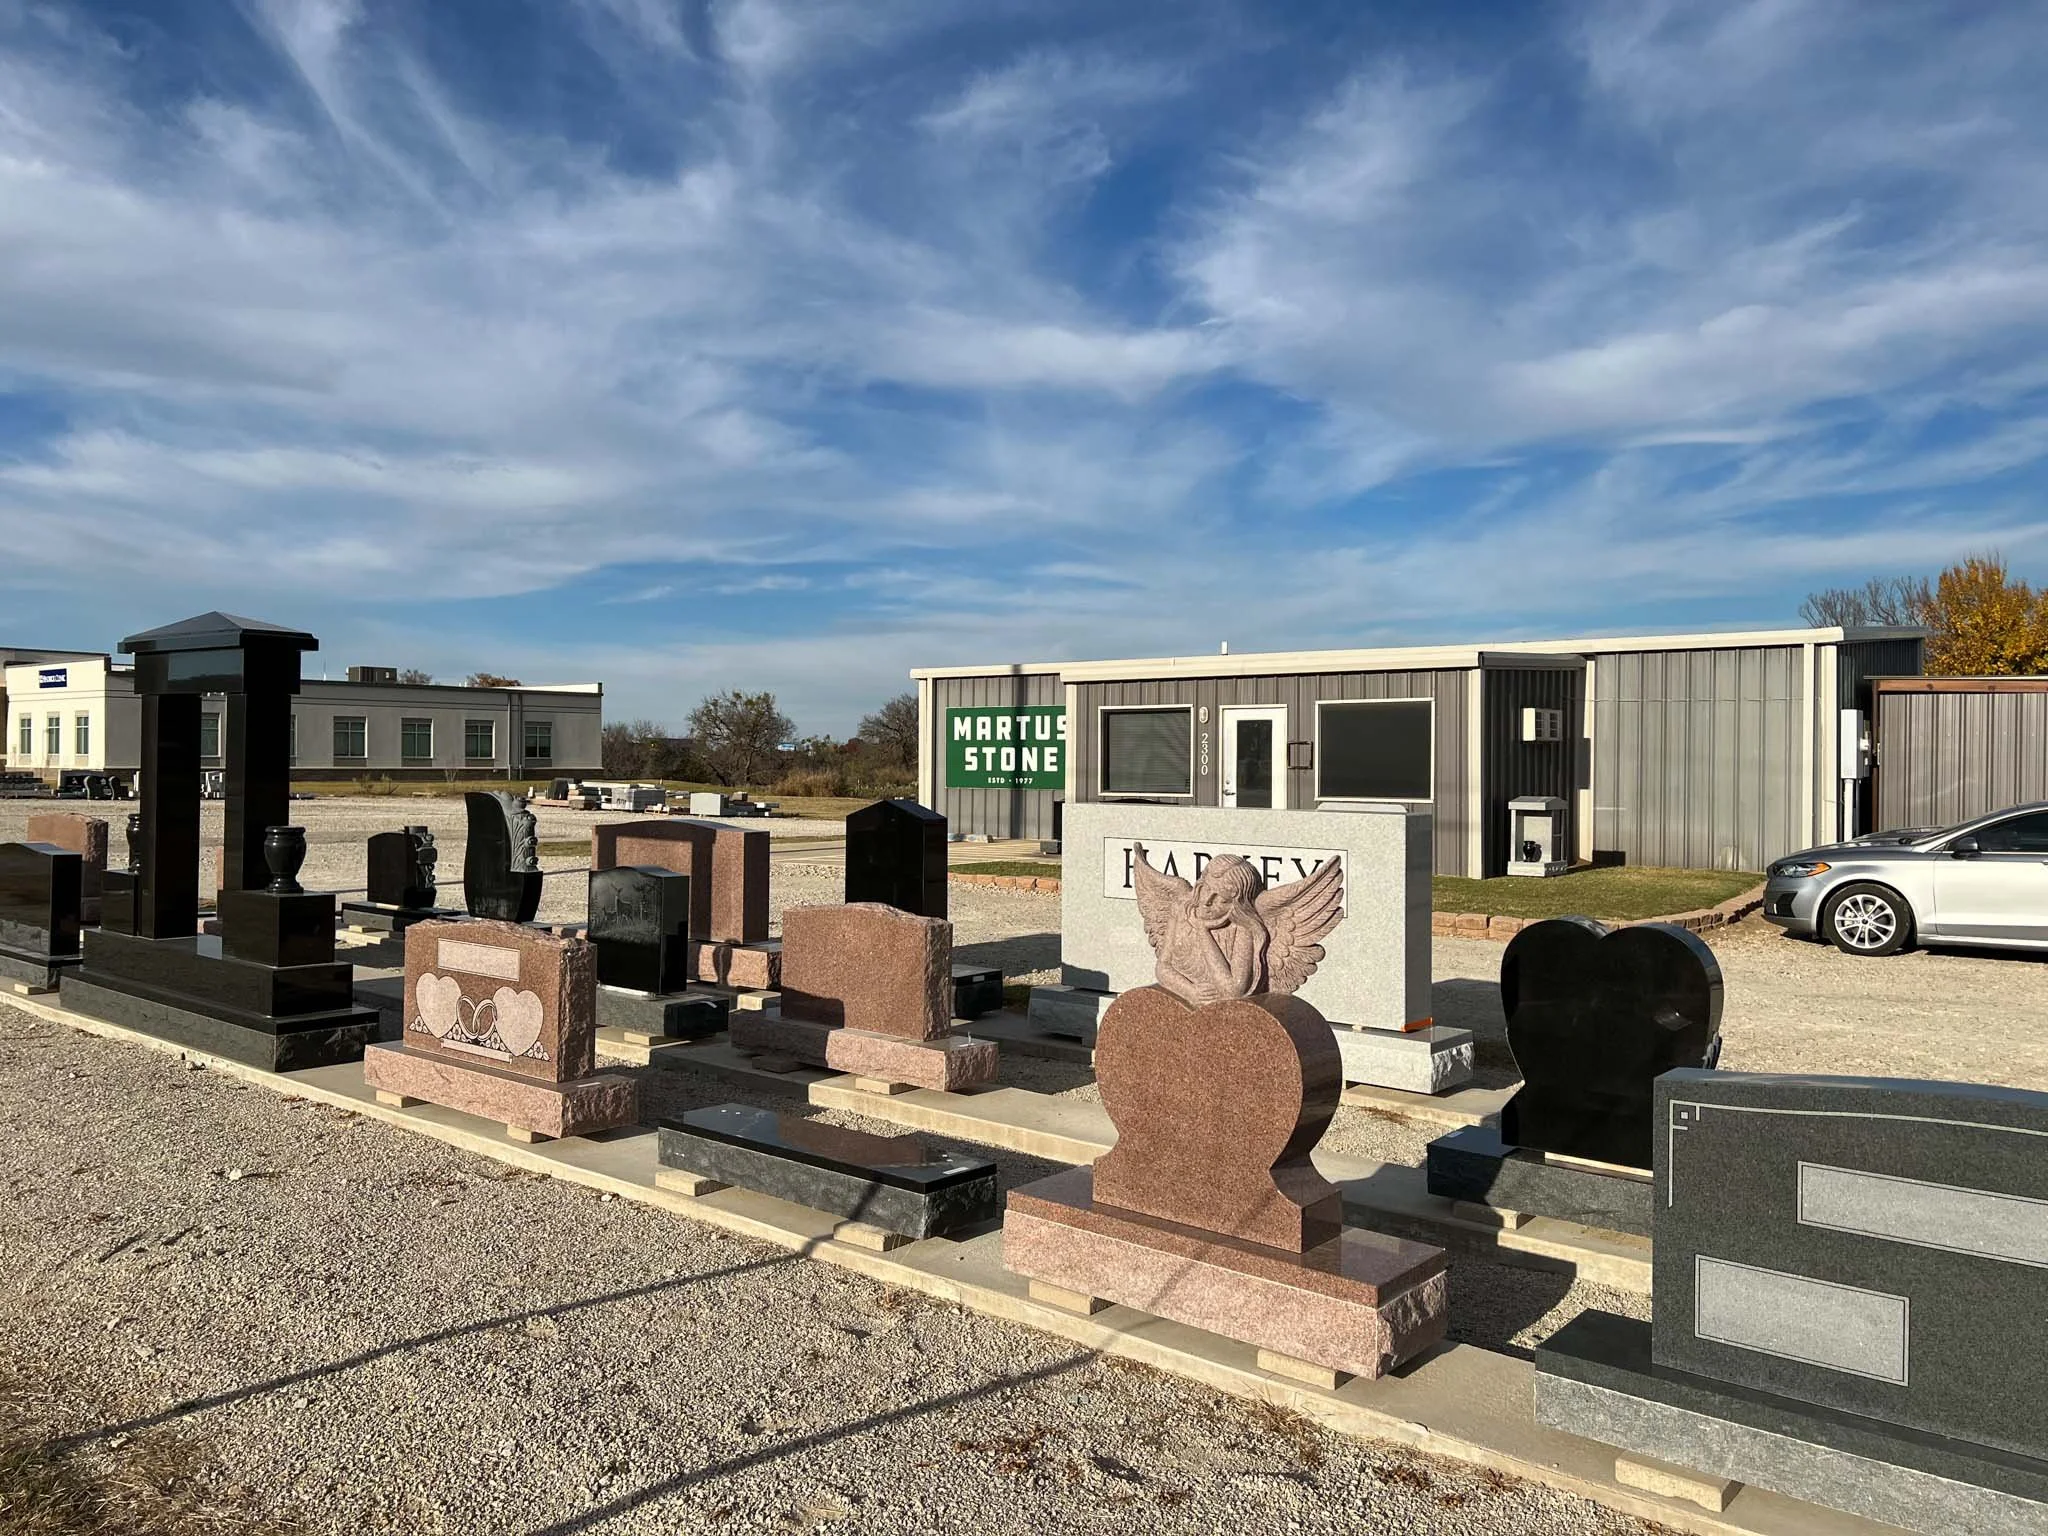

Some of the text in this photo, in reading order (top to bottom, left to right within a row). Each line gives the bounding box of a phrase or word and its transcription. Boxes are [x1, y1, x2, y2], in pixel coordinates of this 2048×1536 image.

[954, 715, 1066, 740] MARTUS
[965, 747, 1058, 771] STONE
[1201, 732, 1209, 776] 2300
